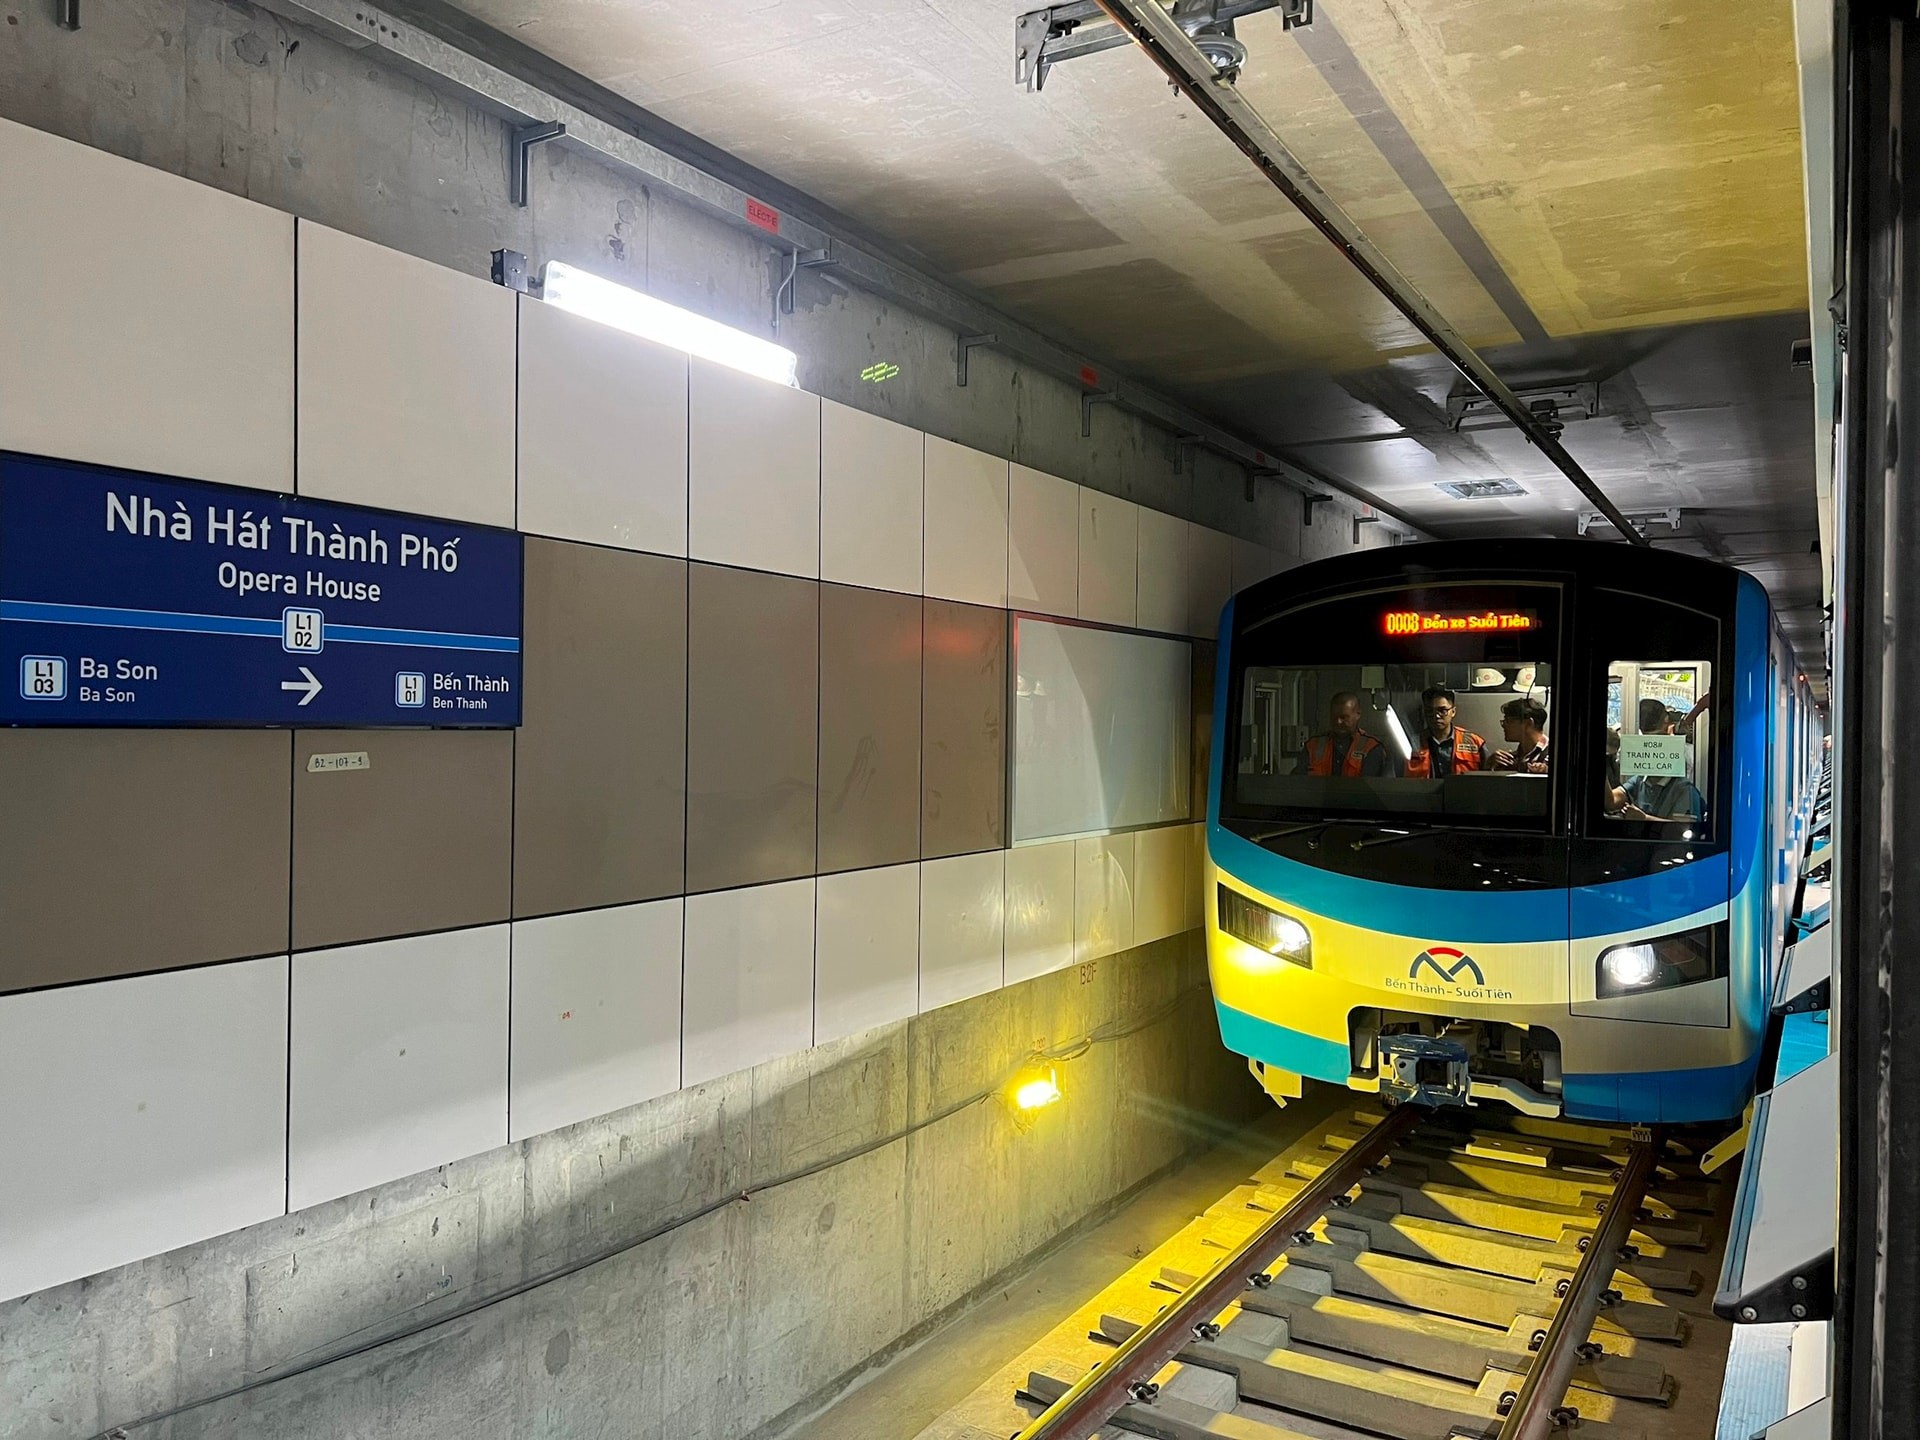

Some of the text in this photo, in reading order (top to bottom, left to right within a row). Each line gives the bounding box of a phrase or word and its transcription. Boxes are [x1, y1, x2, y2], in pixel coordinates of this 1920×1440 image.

[106, 491, 461, 573] Nhà Hát Thành Phố
[218, 561, 381, 602] Opera House
[295, 613, 312, 631] L1
[1450, 618, 1466, 628] xe
[294, 631, 313, 648] 02
[34, 661, 54, 677] L1
[80, 657, 158, 681] Ba Son
[33, 678, 55, 694] 03
[404, 676, 417, 690] L1
[433, 672, 510, 693] Bến Thành
[80, 686, 136, 703] Ba Son
[404, 690, 417, 703] 01
[432, 696, 488, 710] Ben Thanh
[1643, 741, 1663, 749] #08#
[1626, 751, 1680, 760] TRAIN NO. 08
[1633, 762, 1673, 770] MC1. CAR
[1080, 962, 1097, 985] B2F
[1385, 978, 1406, 990] Bến
[1408, 981, 1445, 995] Thành
[1455, 985, 1484, 999] Suối
[1484, 989, 1513, 999] Tiên
